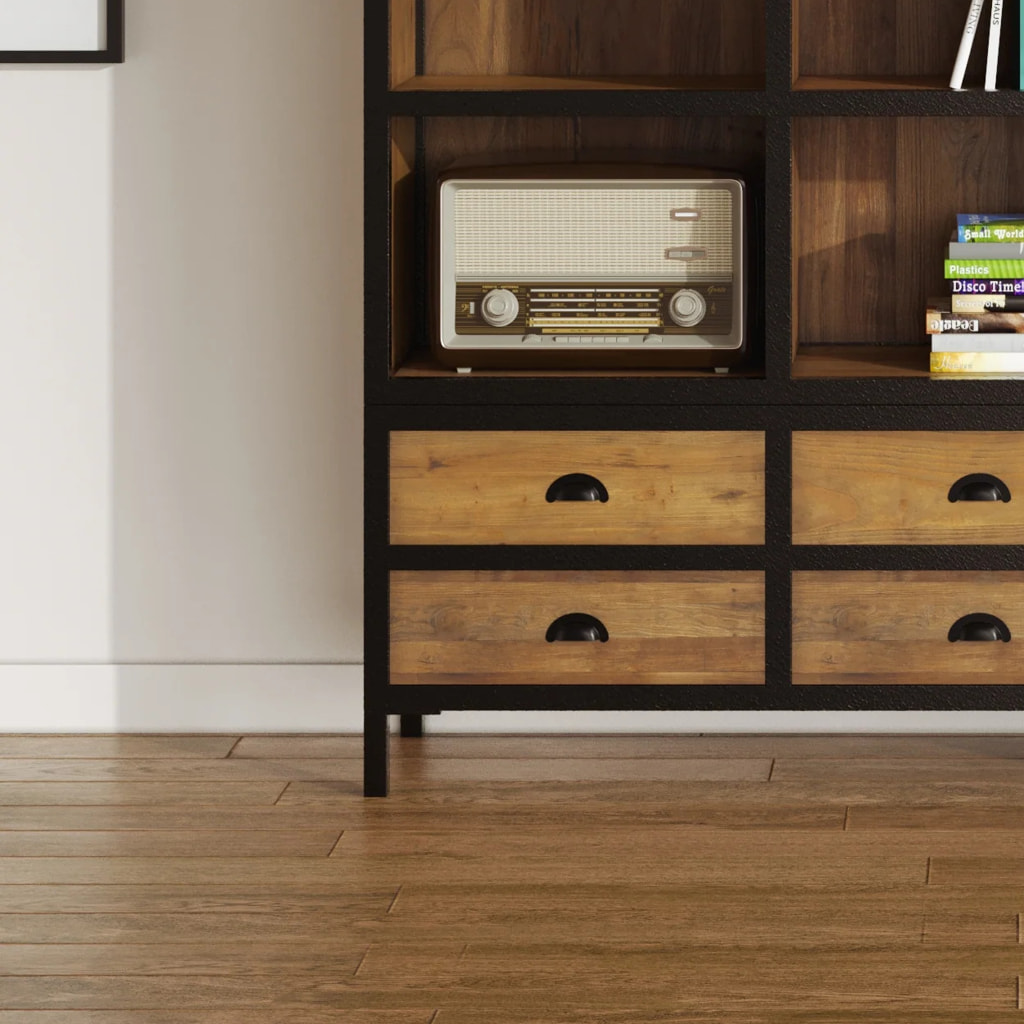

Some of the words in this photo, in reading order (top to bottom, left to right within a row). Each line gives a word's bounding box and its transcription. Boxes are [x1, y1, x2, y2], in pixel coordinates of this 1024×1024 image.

[964, 229, 991, 240] Small
[993, 229, 1024, 240] World
[949, 265, 990, 275] Plastics
[952, 280, 986, 293] Disco
[930, 319, 979, 332] Beagle
